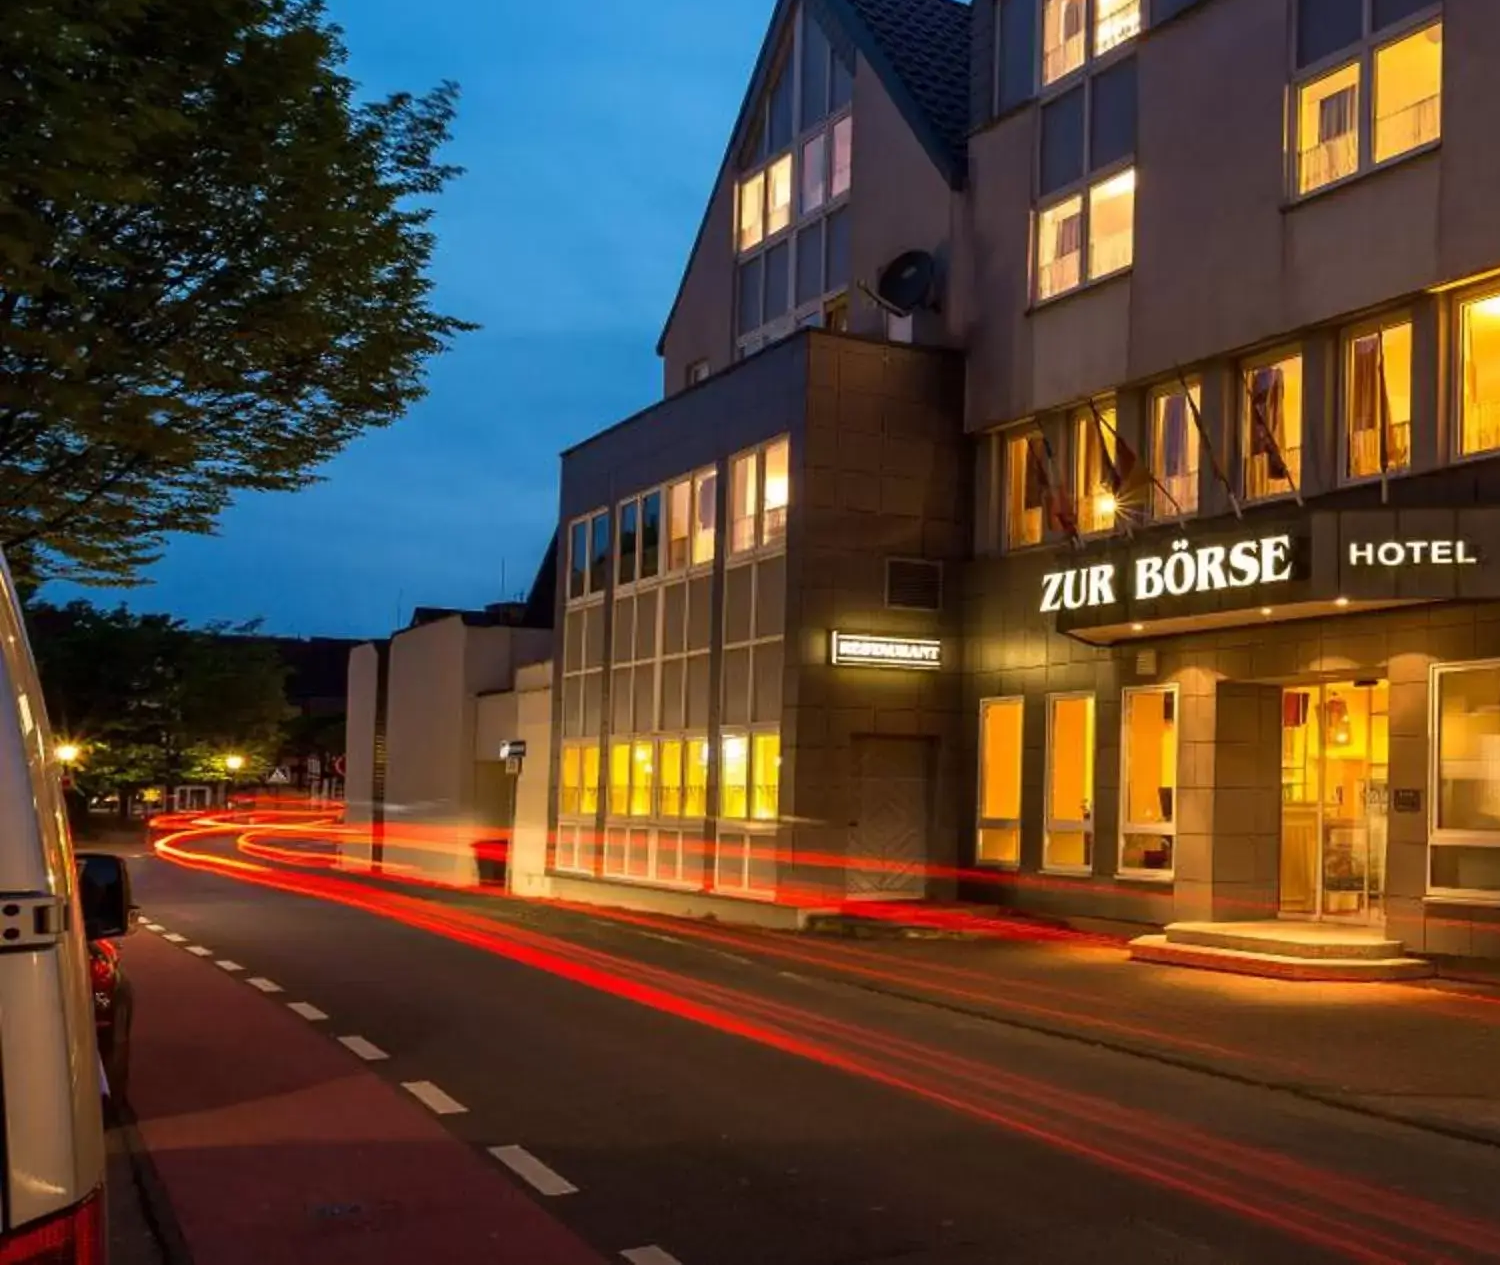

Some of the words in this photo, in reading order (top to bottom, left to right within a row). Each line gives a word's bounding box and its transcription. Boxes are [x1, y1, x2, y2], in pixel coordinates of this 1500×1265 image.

[1039, 563, 1116, 613] ZUR
[1135, 534, 1292, 600] BÖRSE
[1349, 540, 1478, 567] HOTEL
